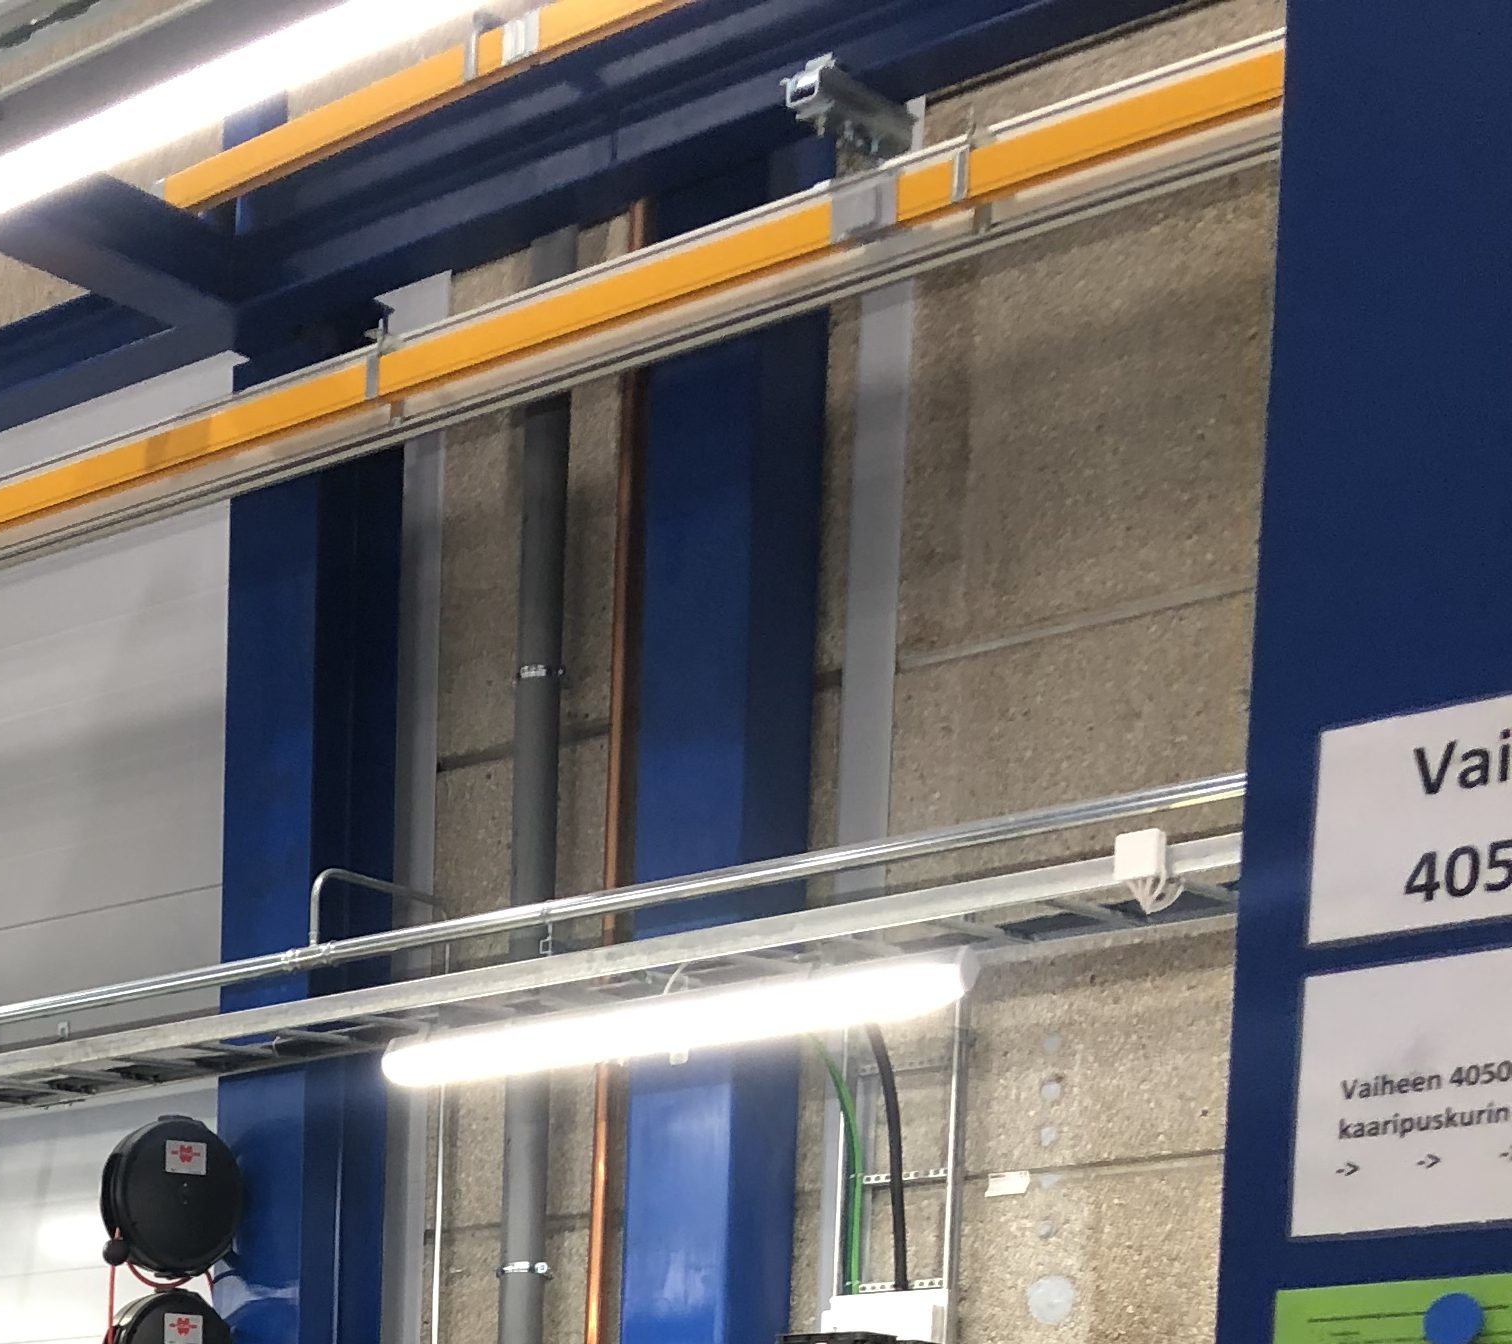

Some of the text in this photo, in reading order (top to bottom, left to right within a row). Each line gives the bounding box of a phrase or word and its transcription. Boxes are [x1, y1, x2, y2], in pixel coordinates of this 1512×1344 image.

[1413, 728, 1511, 795] Vai
[1403, 838, 1512, 902] 405
[1340, 1060, 1512, 1100] Vaiheen 4050
[1338, 1102, 1509, 1139] kaaripuskurin
